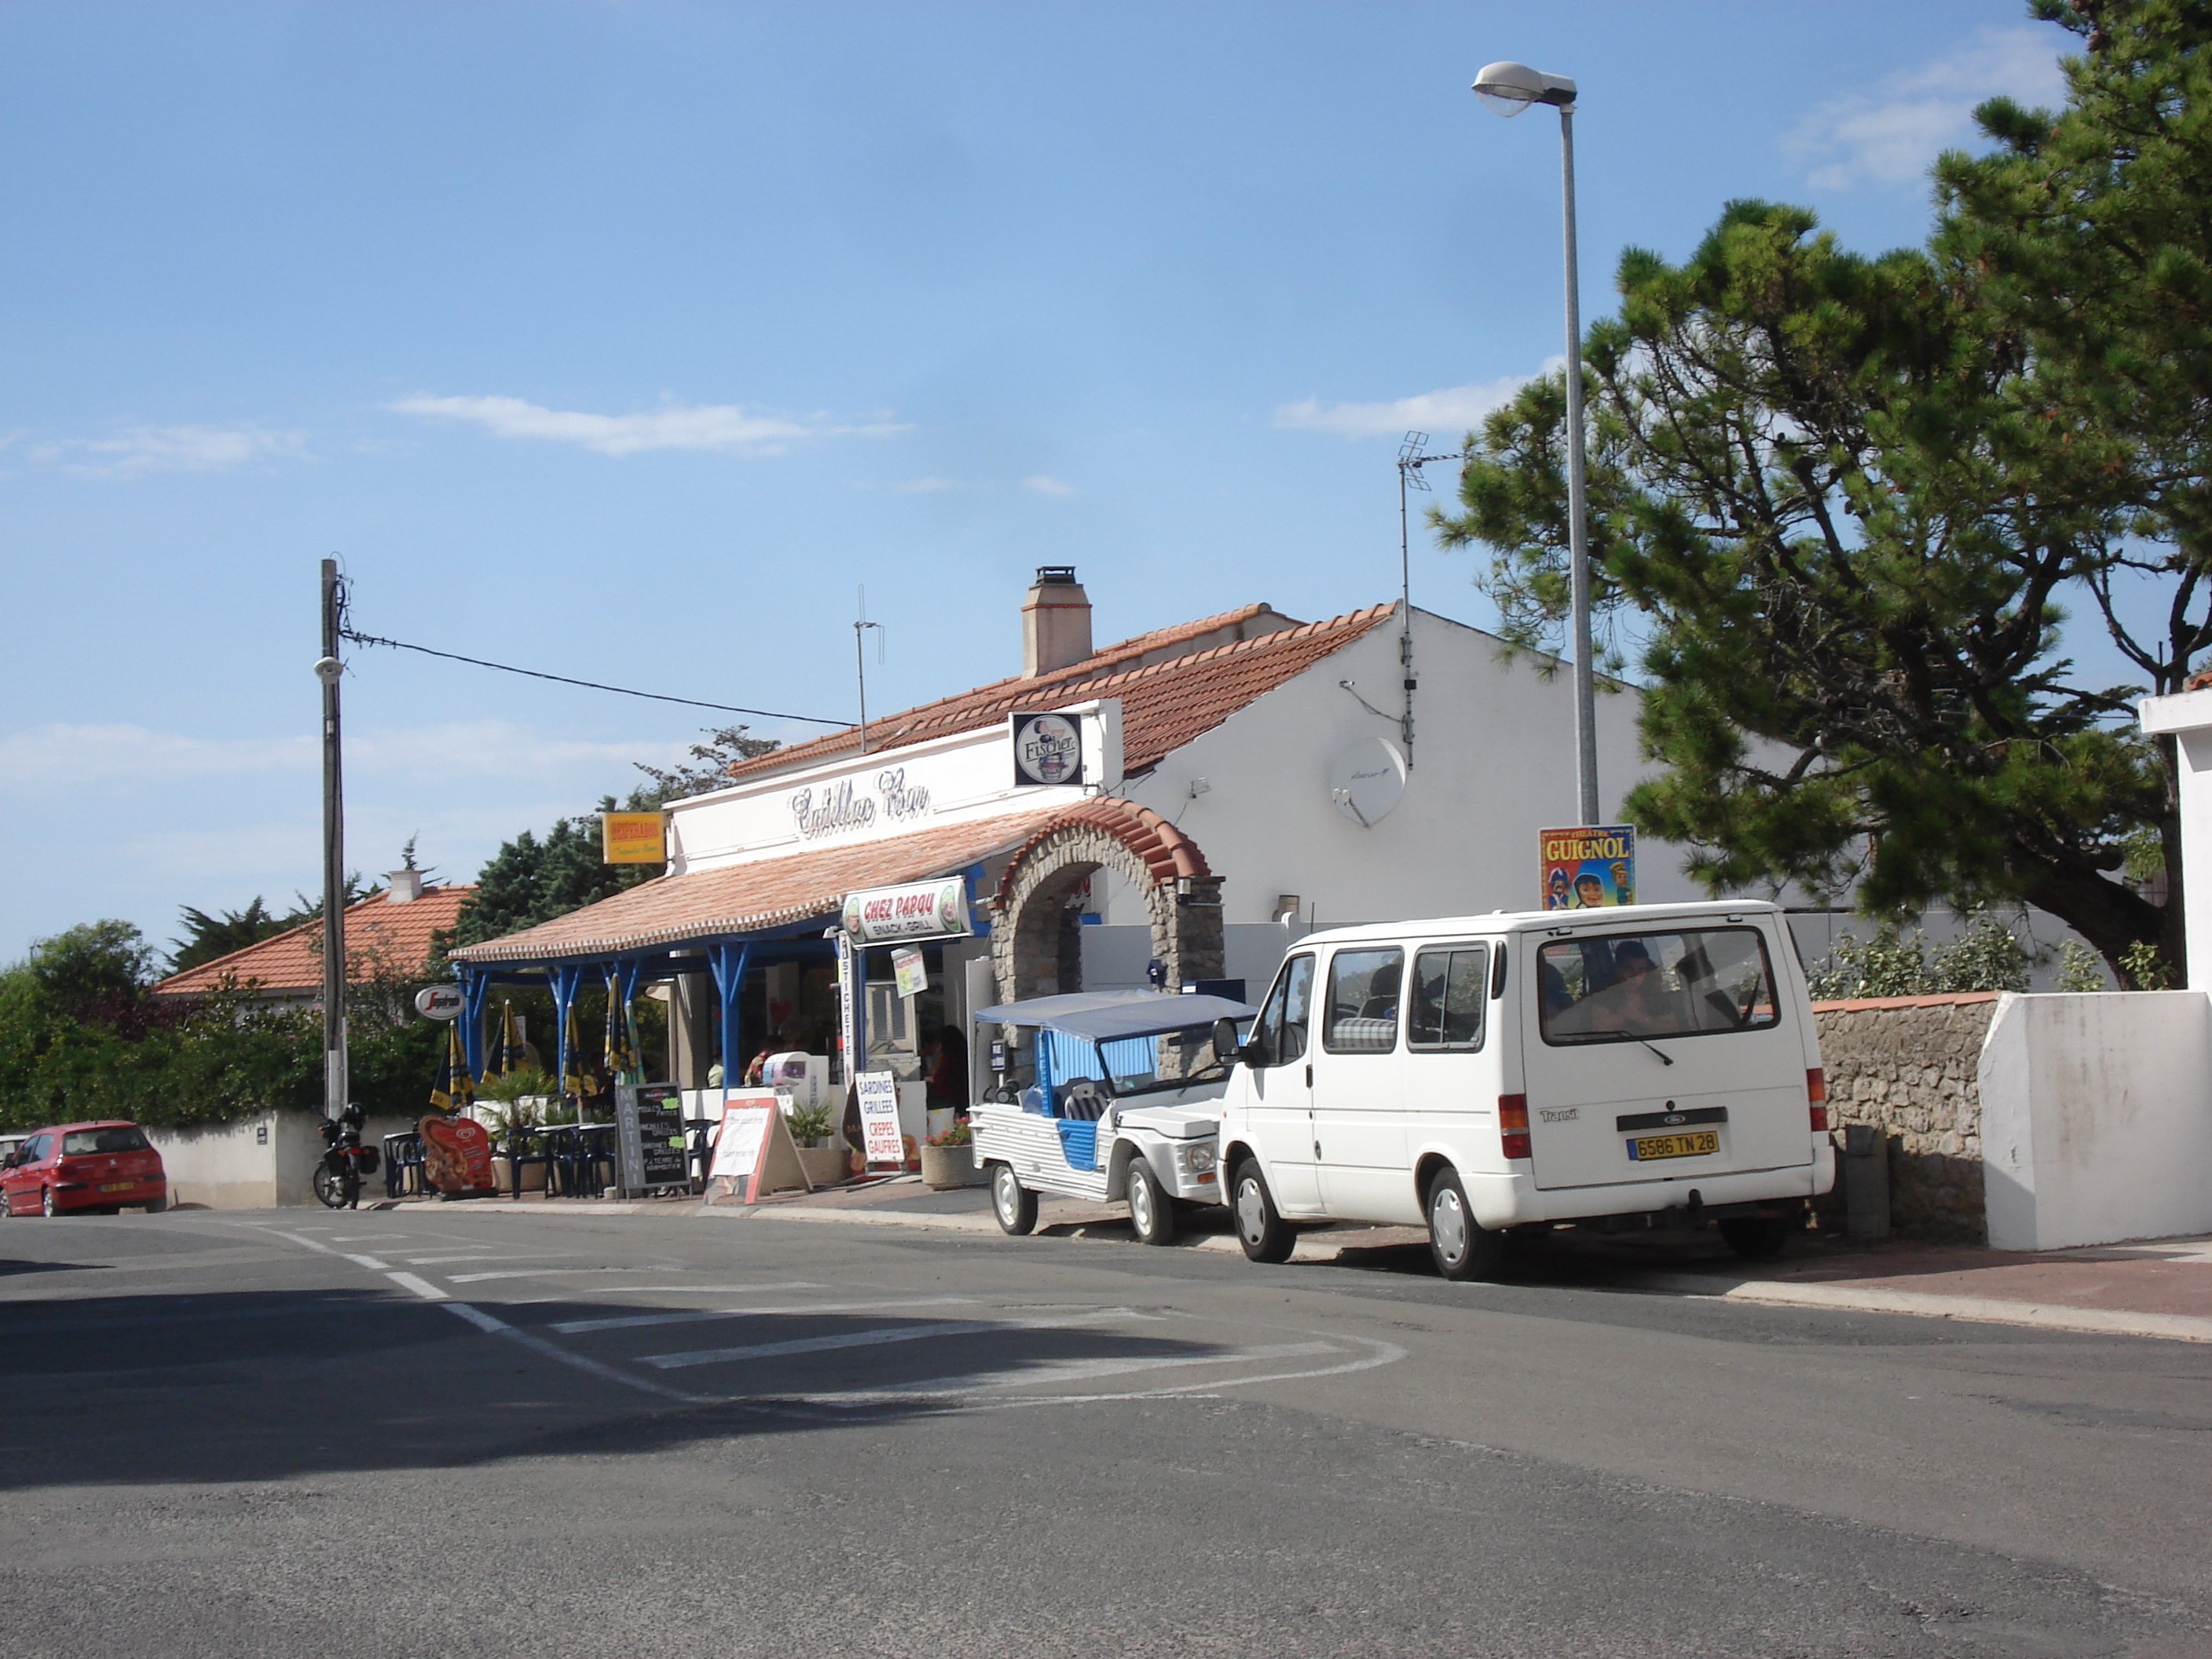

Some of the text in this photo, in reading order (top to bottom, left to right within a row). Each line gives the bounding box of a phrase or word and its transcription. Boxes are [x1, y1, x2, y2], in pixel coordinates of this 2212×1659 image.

[1025, 736, 1072, 759] Fischer
[1546, 837, 1629, 861] GUIGNOL
[865, 892, 936, 922] CHEZ PAPOU
[873, 920, 933, 936] SNACK GRILL
[859, 1079, 893, 1095] SARDINES
[864, 1100, 894, 1114] GRILLEES
[1540, 1108, 1579, 1122] Transit
[619, 1088, 639, 1185] MARTINI
[870, 1122, 895, 1136] CREPES
[868, 1140, 900, 1154] GAUFRES
[1638, 1135, 1716, 1156] 6586 TN 28
